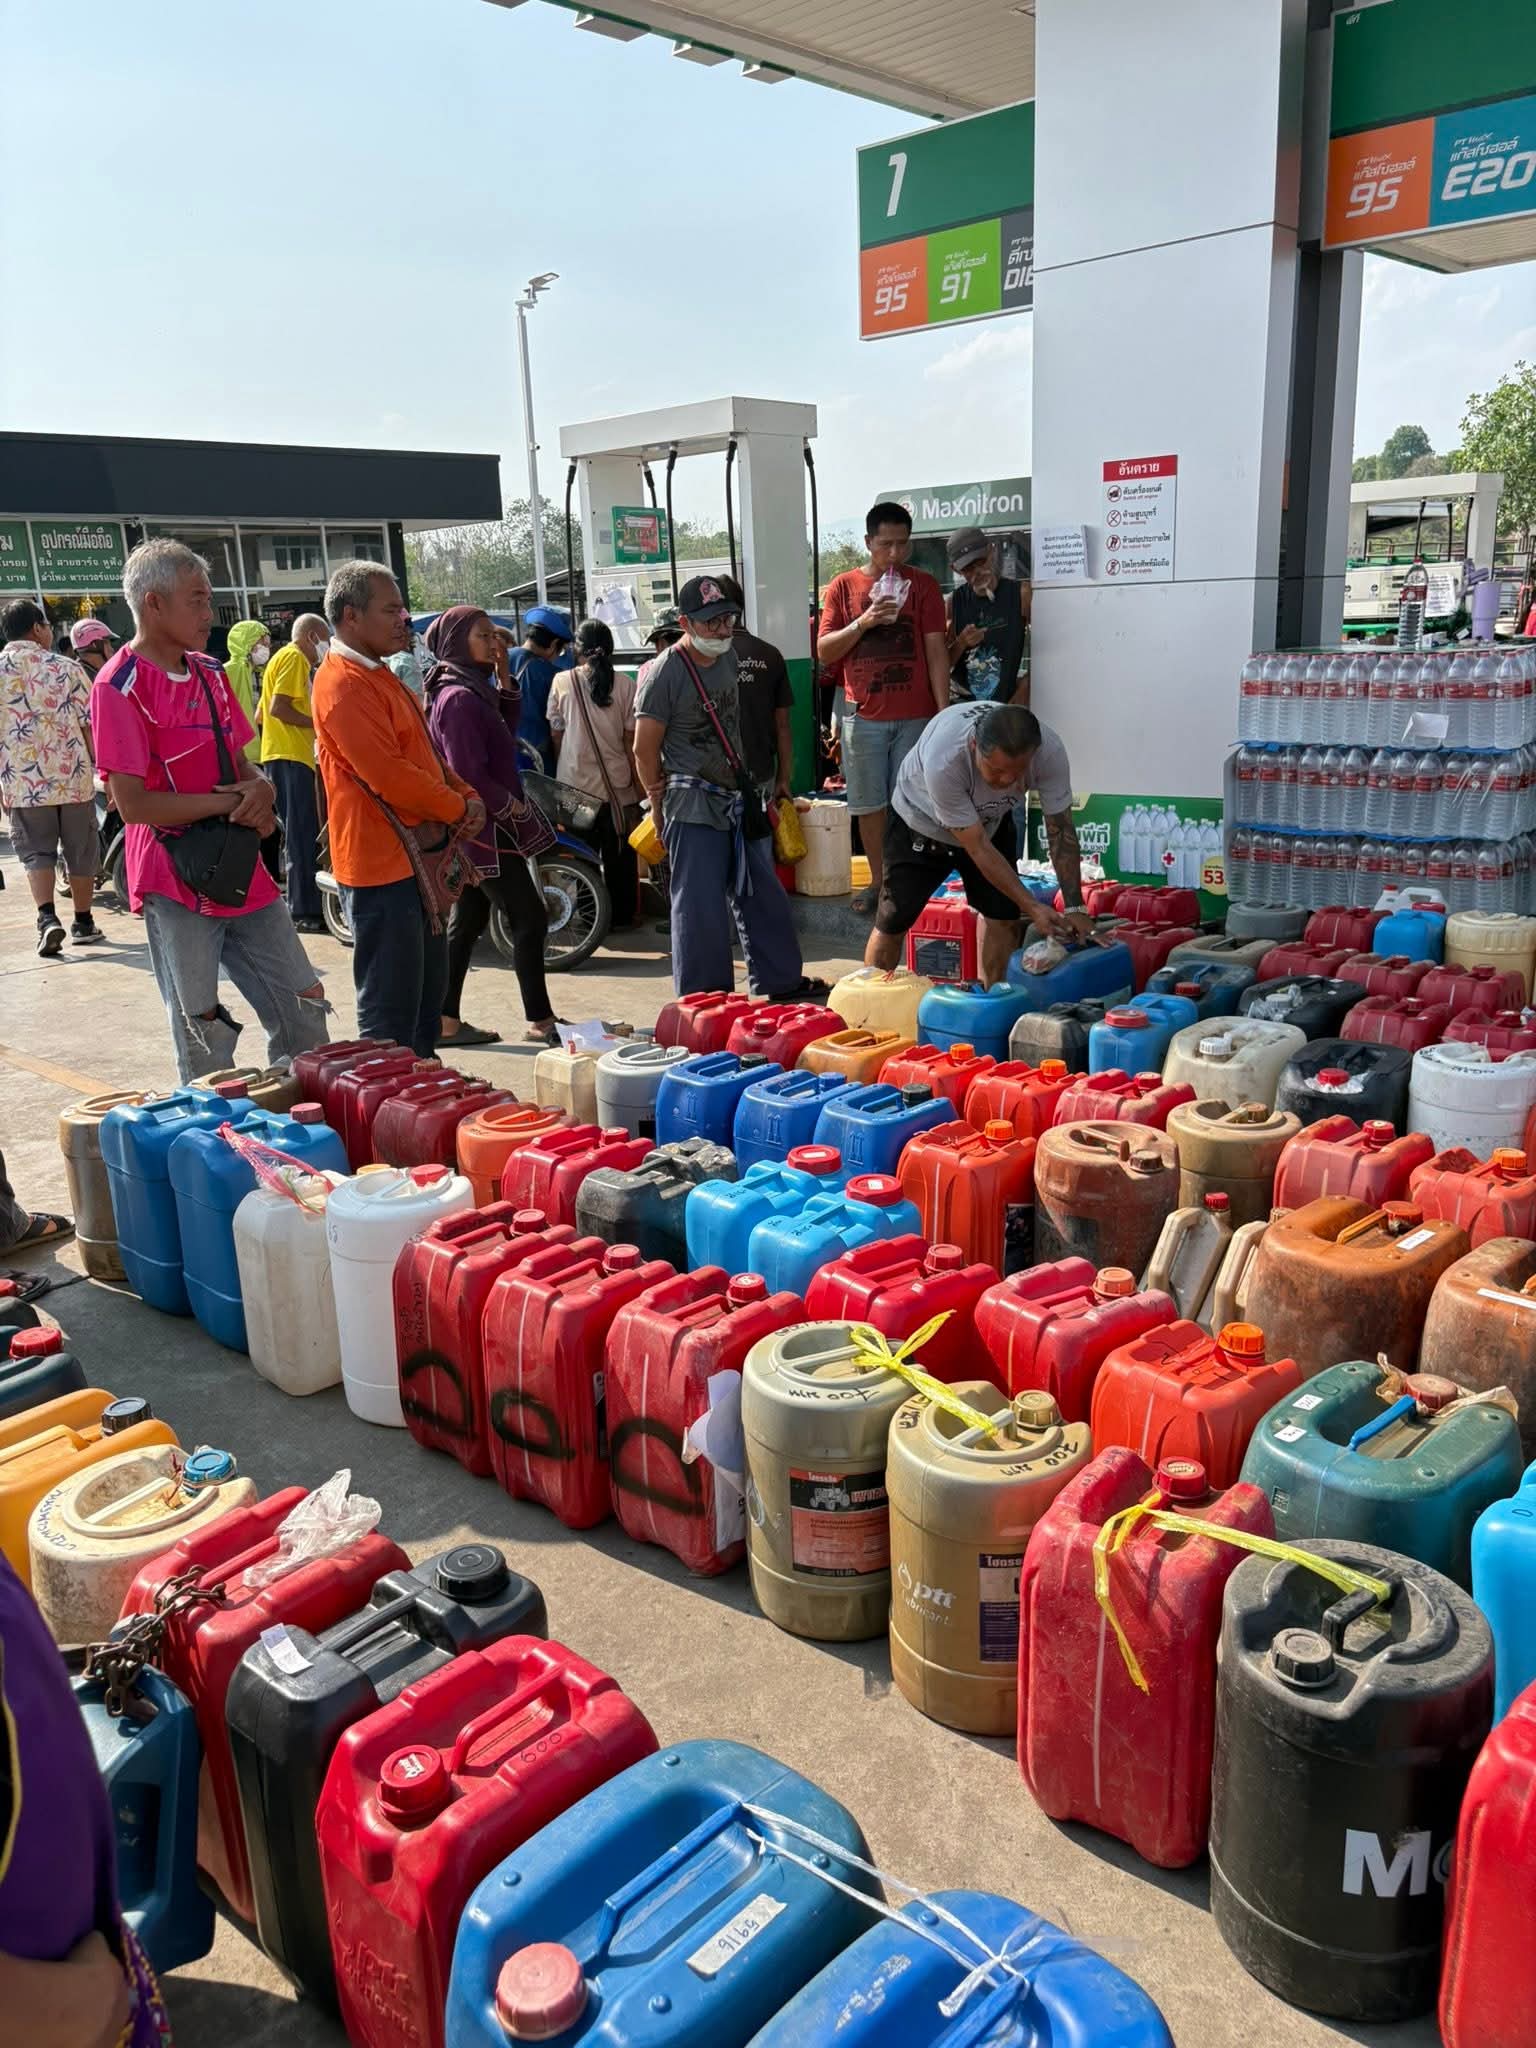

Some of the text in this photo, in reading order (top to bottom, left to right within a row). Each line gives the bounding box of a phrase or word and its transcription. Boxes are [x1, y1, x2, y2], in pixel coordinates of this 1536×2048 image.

[886, 152, 908, 217] 1
[1441, 150, 1536, 201] E20
[1345, 175, 1403, 219] 95
[874, 283, 909, 317] 95
[940, 271, 972, 305] 91
[1118, 461, 1160, 476] อันตราย
[922, 493, 1024, 521] Maxnitron
[41, 526, 113, 559] อุปกรณ์มือถือ
[1204, 869, 1225, 885] 53
